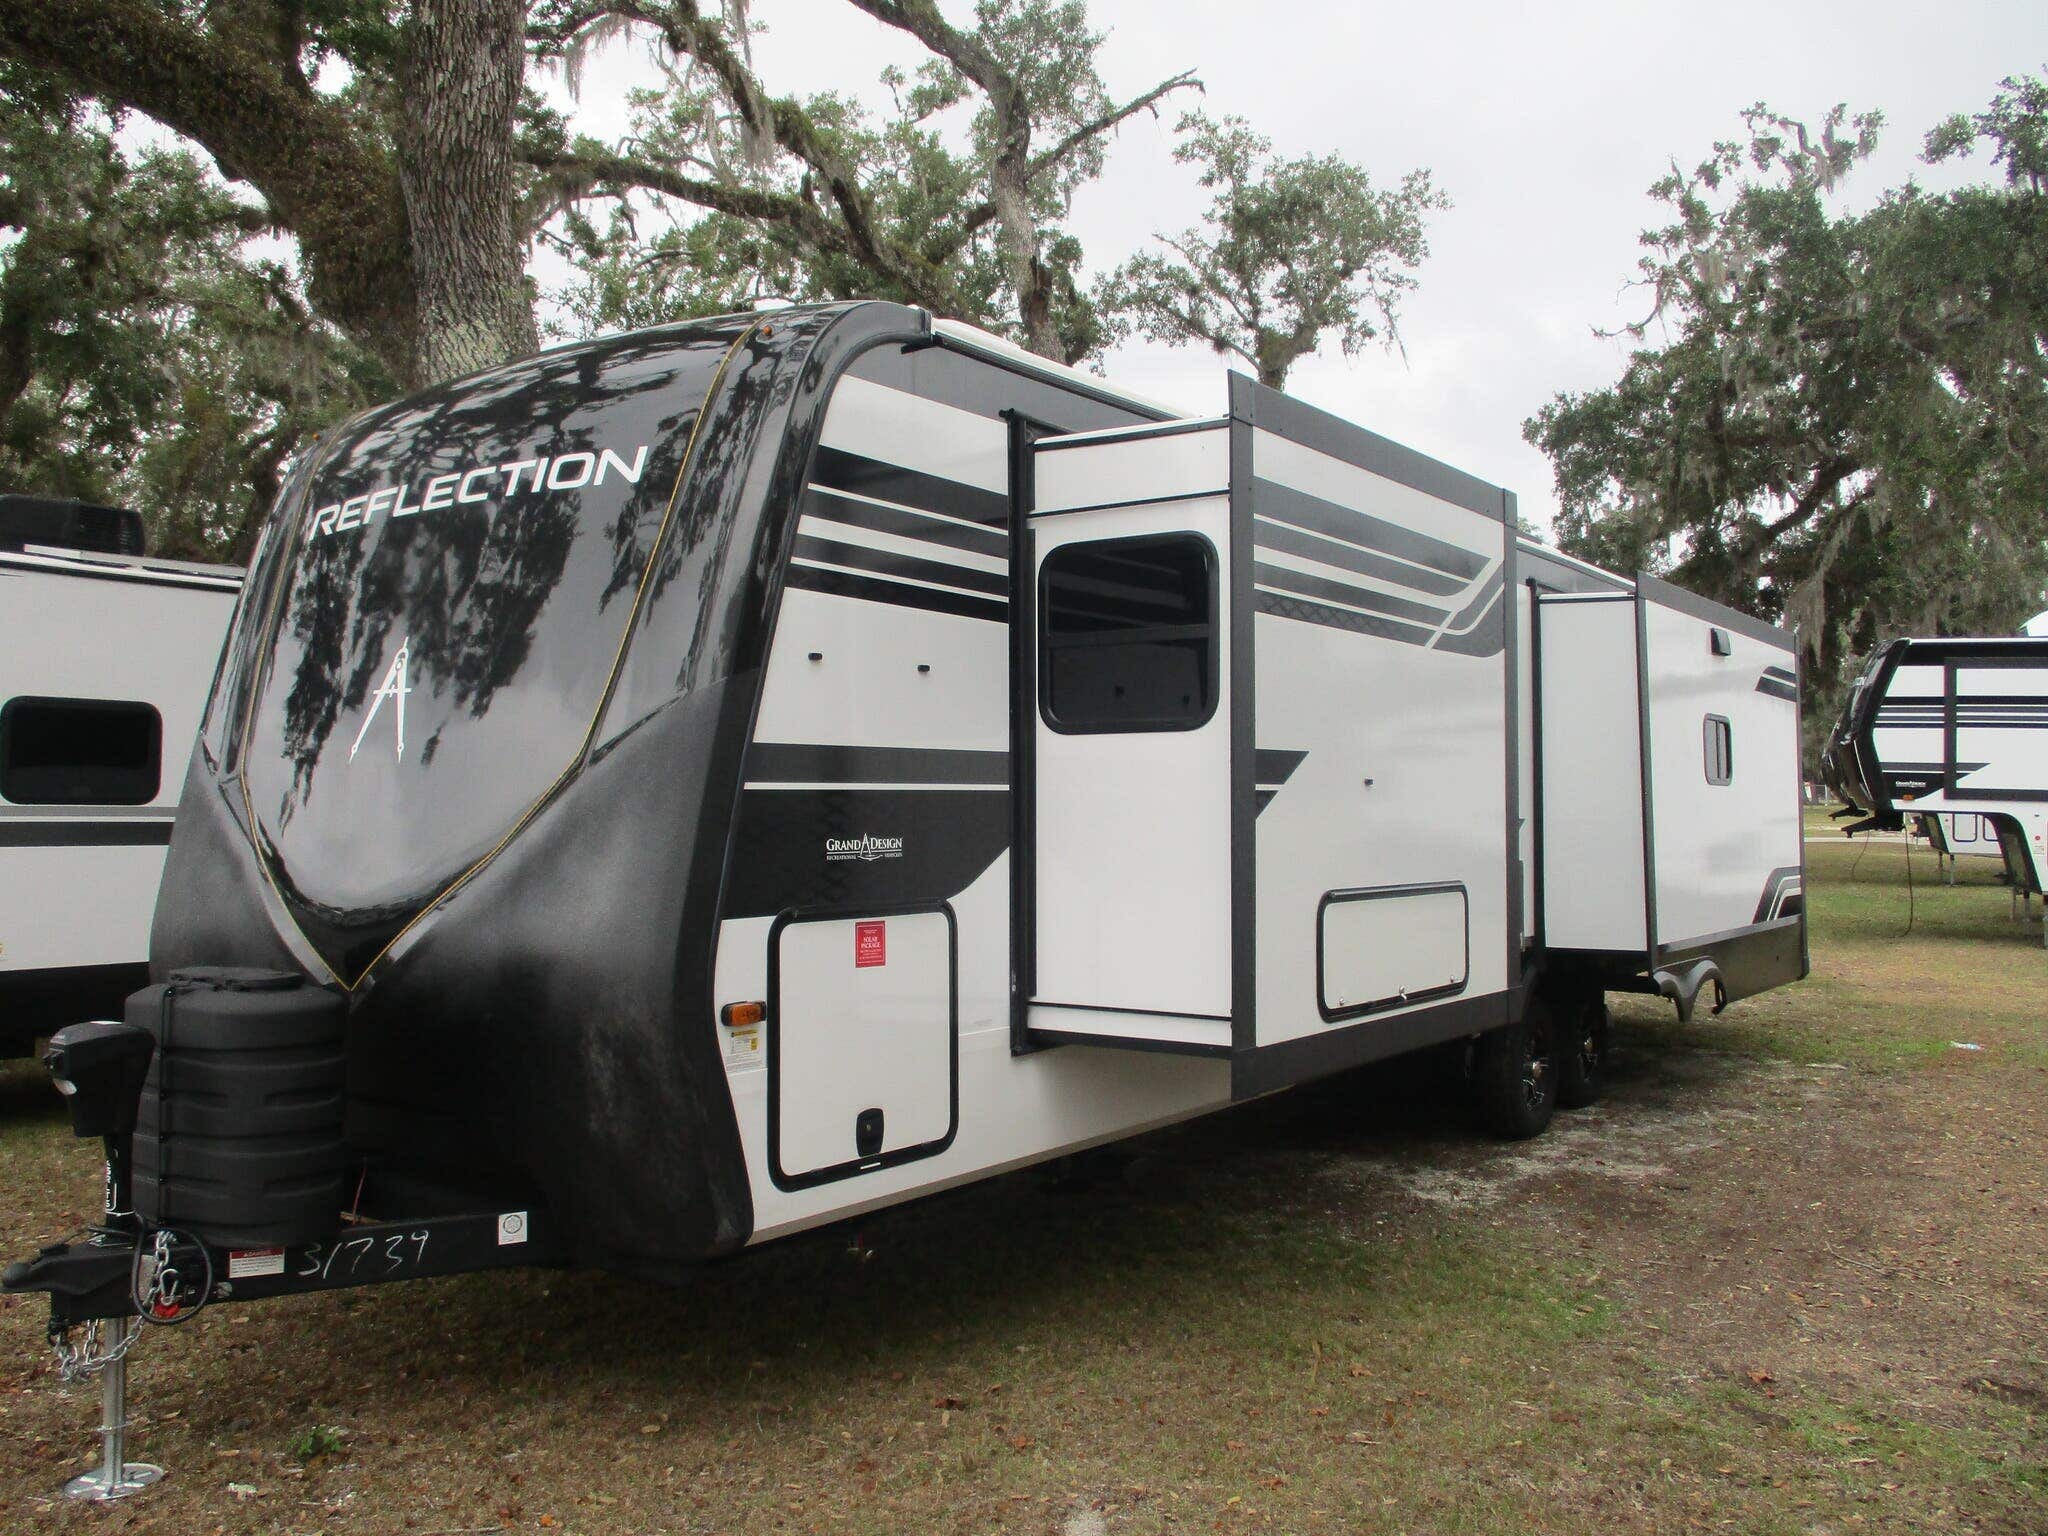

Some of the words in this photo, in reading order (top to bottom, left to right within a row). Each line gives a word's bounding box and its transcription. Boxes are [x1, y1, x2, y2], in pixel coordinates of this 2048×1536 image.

[309, 446, 648, 541] REFLECTION
[826, 838, 861, 851] GRAND
[870, 837, 902, 849] DESIGN
[298, 1230, 429, 1279] 31739
